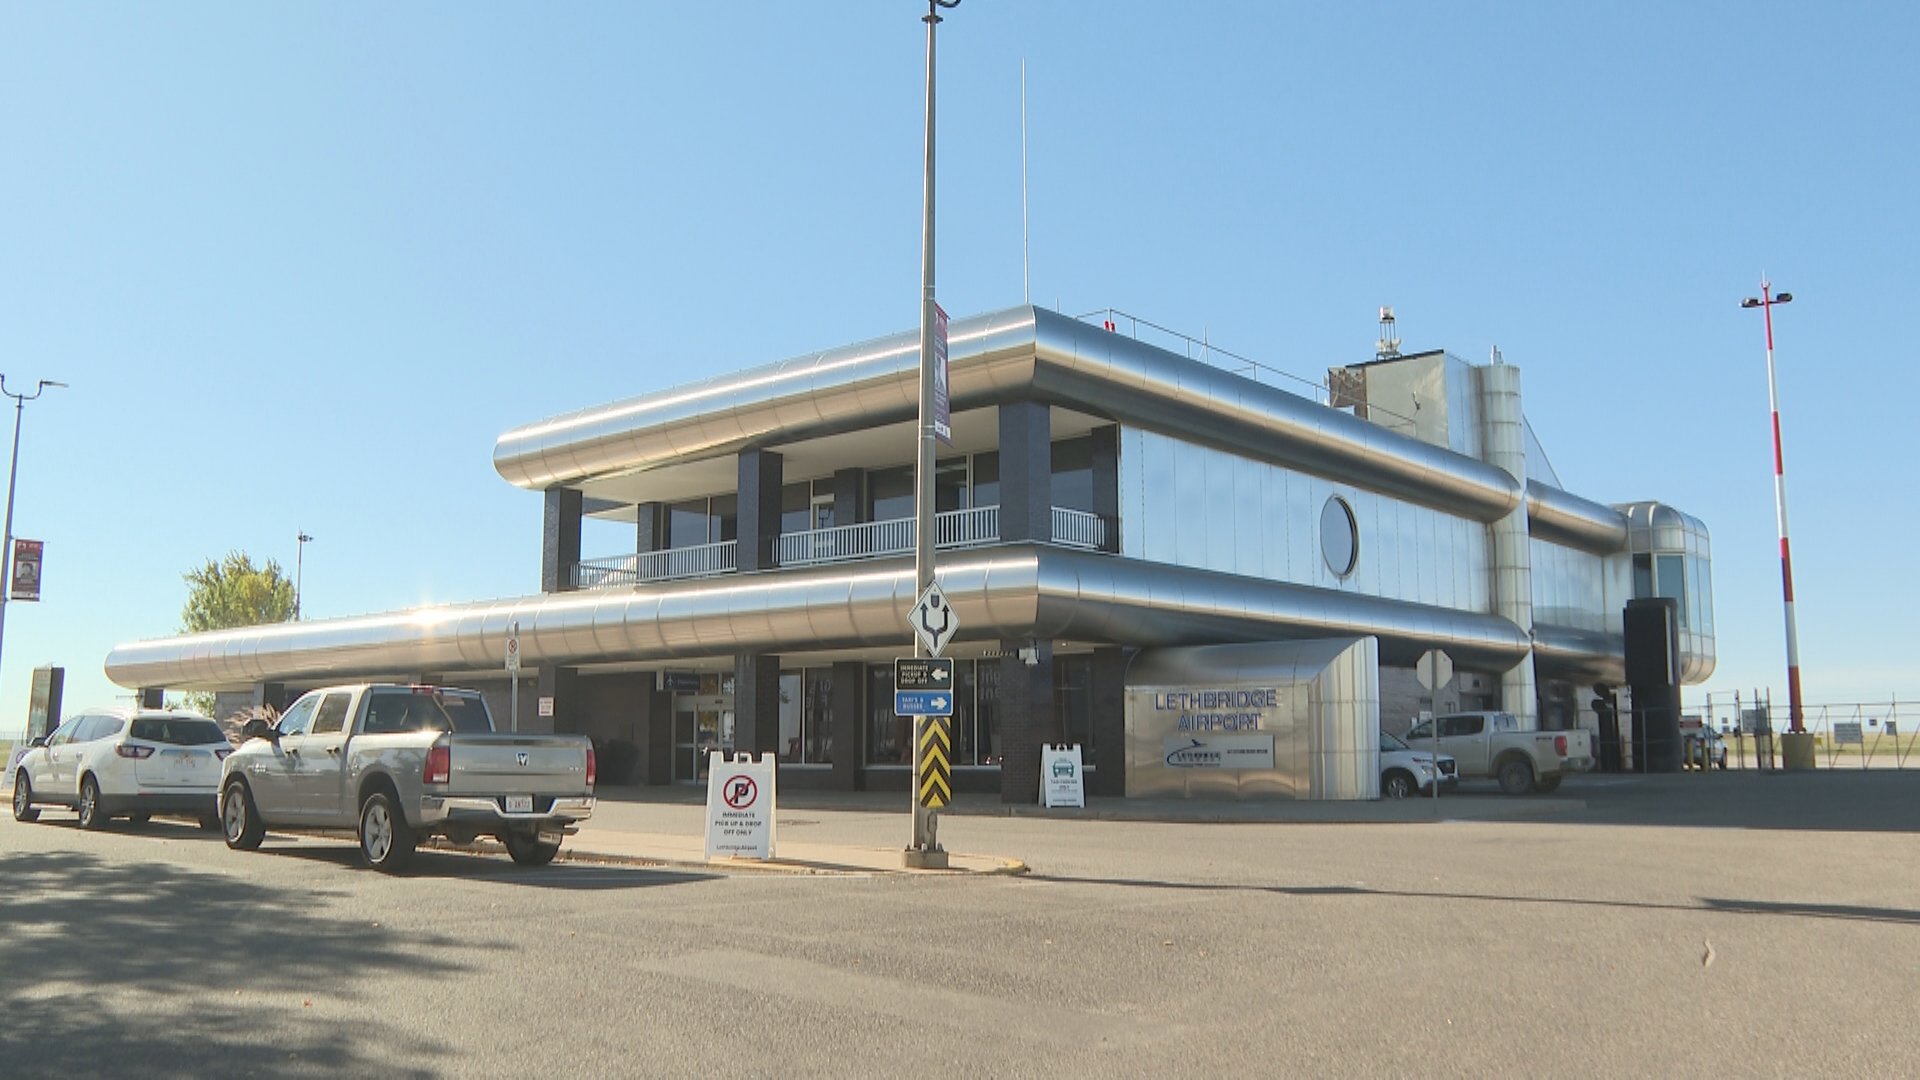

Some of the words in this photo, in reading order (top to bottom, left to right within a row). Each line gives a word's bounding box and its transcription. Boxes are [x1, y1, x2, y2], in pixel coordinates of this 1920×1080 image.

[1155, 689, 1277, 711] LETHBRIDGE
[1177, 712, 1261, 732] AIRPORT
[722, 811, 756, 819] IMMEDIATE
[745, 820, 762, 828] DROP
